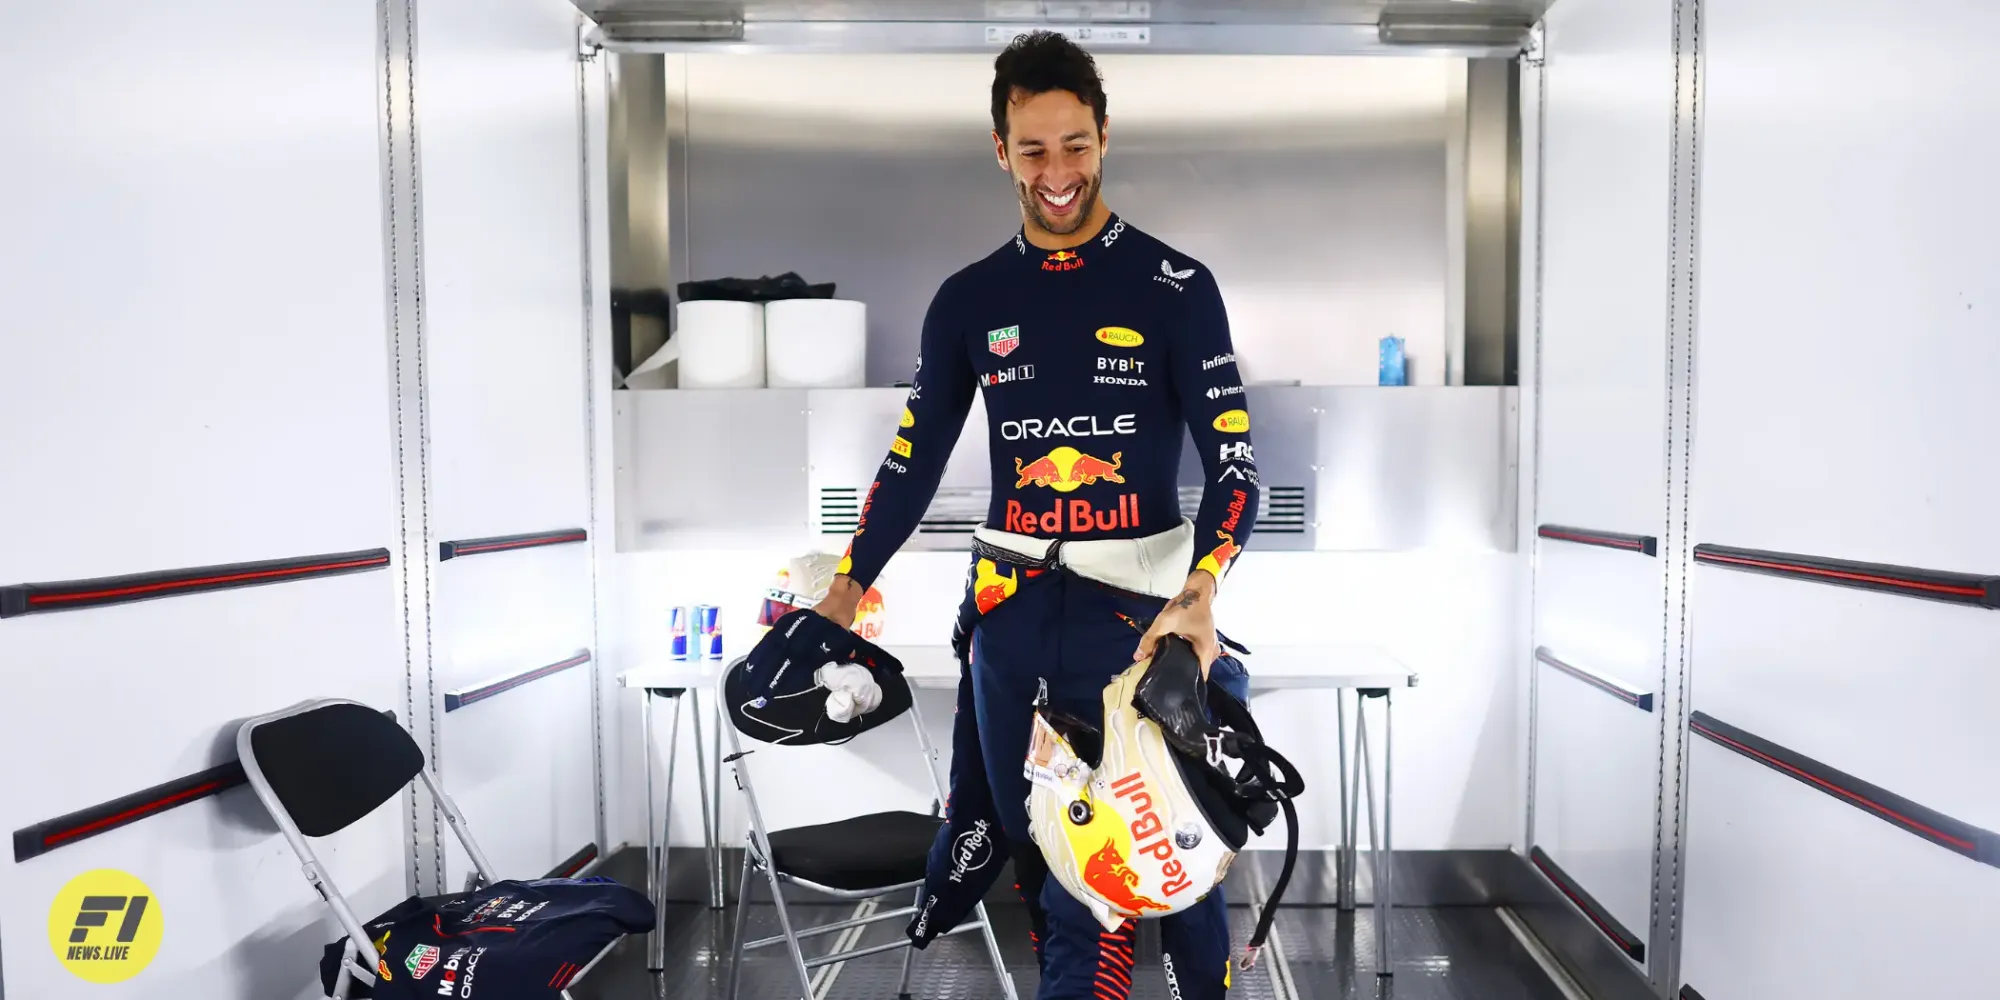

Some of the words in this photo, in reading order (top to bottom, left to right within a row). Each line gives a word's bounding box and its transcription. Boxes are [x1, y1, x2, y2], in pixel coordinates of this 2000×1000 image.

[1041, 260, 1062, 271] Red
[1063, 257, 1084, 270] Bull
[1153, 275, 1184, 293] CASTORE
[990, 328, 1017, 341] TAG
[1108, 331, 1138, 343] RAUCH
[990, 339, 1018, 355] HEUER
[1097, 356, 1145, 374] BYBIT
[980, 367, 1016, 388] Mobil
[1093, 375, 1148, 387] HONDA
[1001, 413, 1137, 441] ORACLE
[883, 457, 907, 474] App
[1230, 489, 1248, 512] Bull
[1005, 498, 1063, 534] Red
[1069, 493, 1140, 533] Bull
[1222, 508, 1240, 532] Red
[1110, 771, 1164, 842] Bull
[949, 846, 973, 883] Hard
[964, 819, 988, 851] Rock
[1138, 838, 1193, 898] Red
[405, 946, 427, 972] TAG
[461, 946, 488, 999] ORACLE
